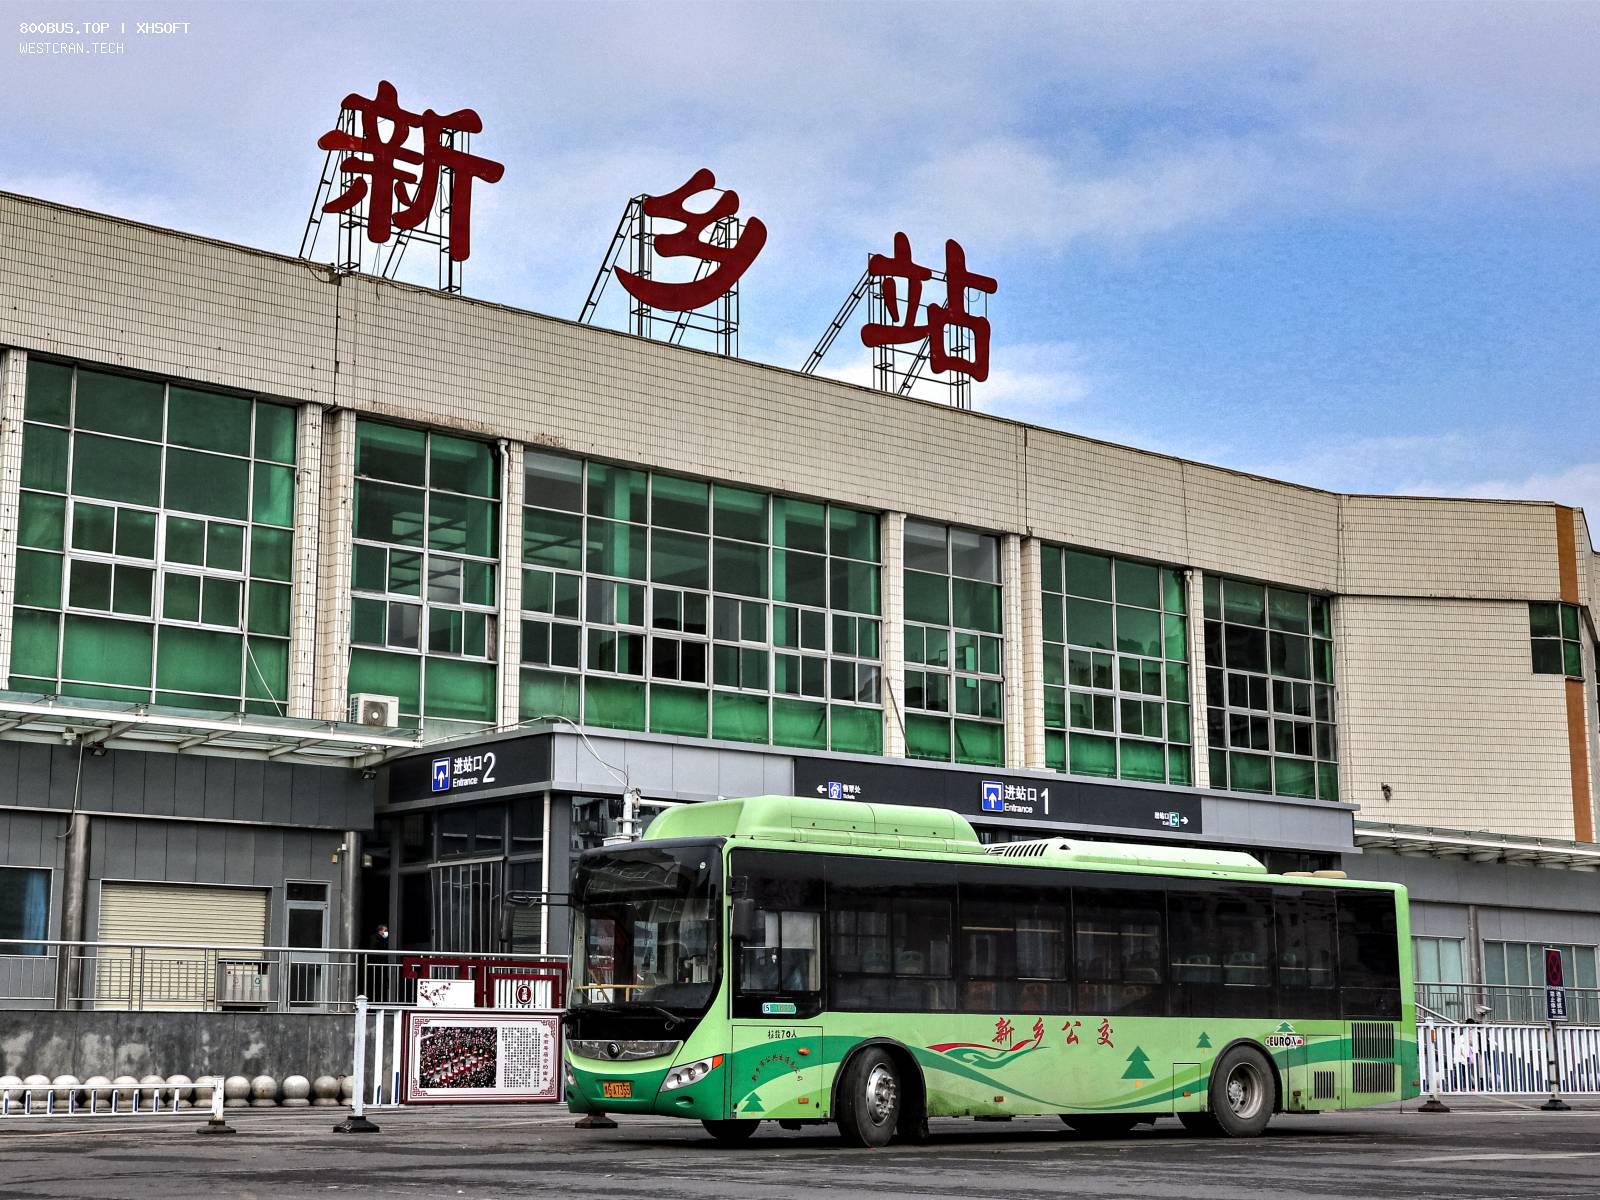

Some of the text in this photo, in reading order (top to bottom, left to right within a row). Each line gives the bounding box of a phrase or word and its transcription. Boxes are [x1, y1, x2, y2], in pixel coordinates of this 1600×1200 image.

[317, 79, 999, 383] 新乡站
[453, 752, 496, 783] 进站口 2
[453, 777, 478, 788] Entrance
[1003, 784, 1050, 815] 进站口 1
[1003, 802, 1034, 815] Entrance
[768, 1029, 797, 1040] 核载70人
[992, 1017, 1114, 1049] 新乡公交
